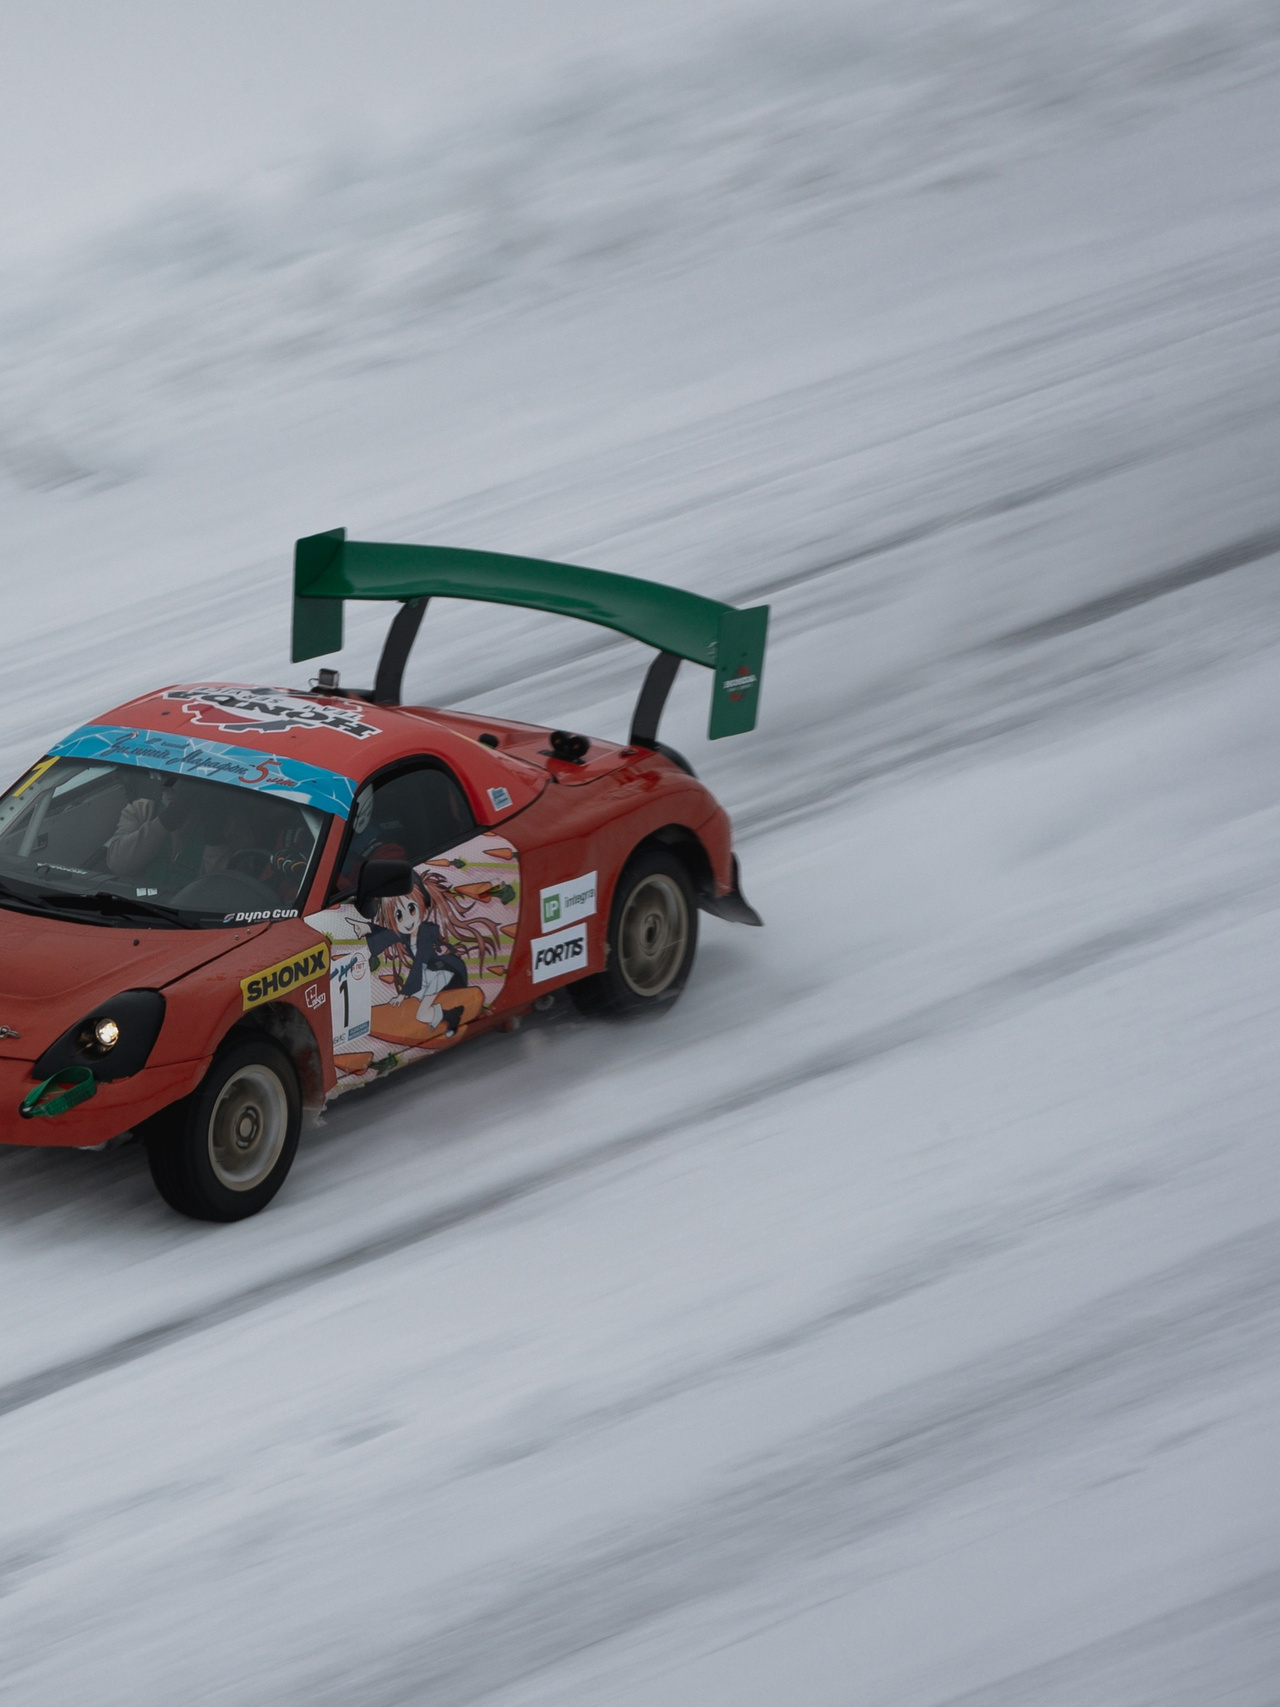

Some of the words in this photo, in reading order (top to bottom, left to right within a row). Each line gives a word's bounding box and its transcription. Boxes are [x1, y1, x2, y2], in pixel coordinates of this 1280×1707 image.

[167, 691, 377, 737] HONDA
[12, 756, 60, 797] 1
[165, 749, 249, 776] Марафон
[238, 758, 282, 784] 5
[235, 911, 271, 923] Dyno
[272, 909, 298, 918] Gun
[534, 937, 584, 970] FORTIS
[247, 950, 326, 1002] SHONX
[339, 980, 350, 1028] 1
